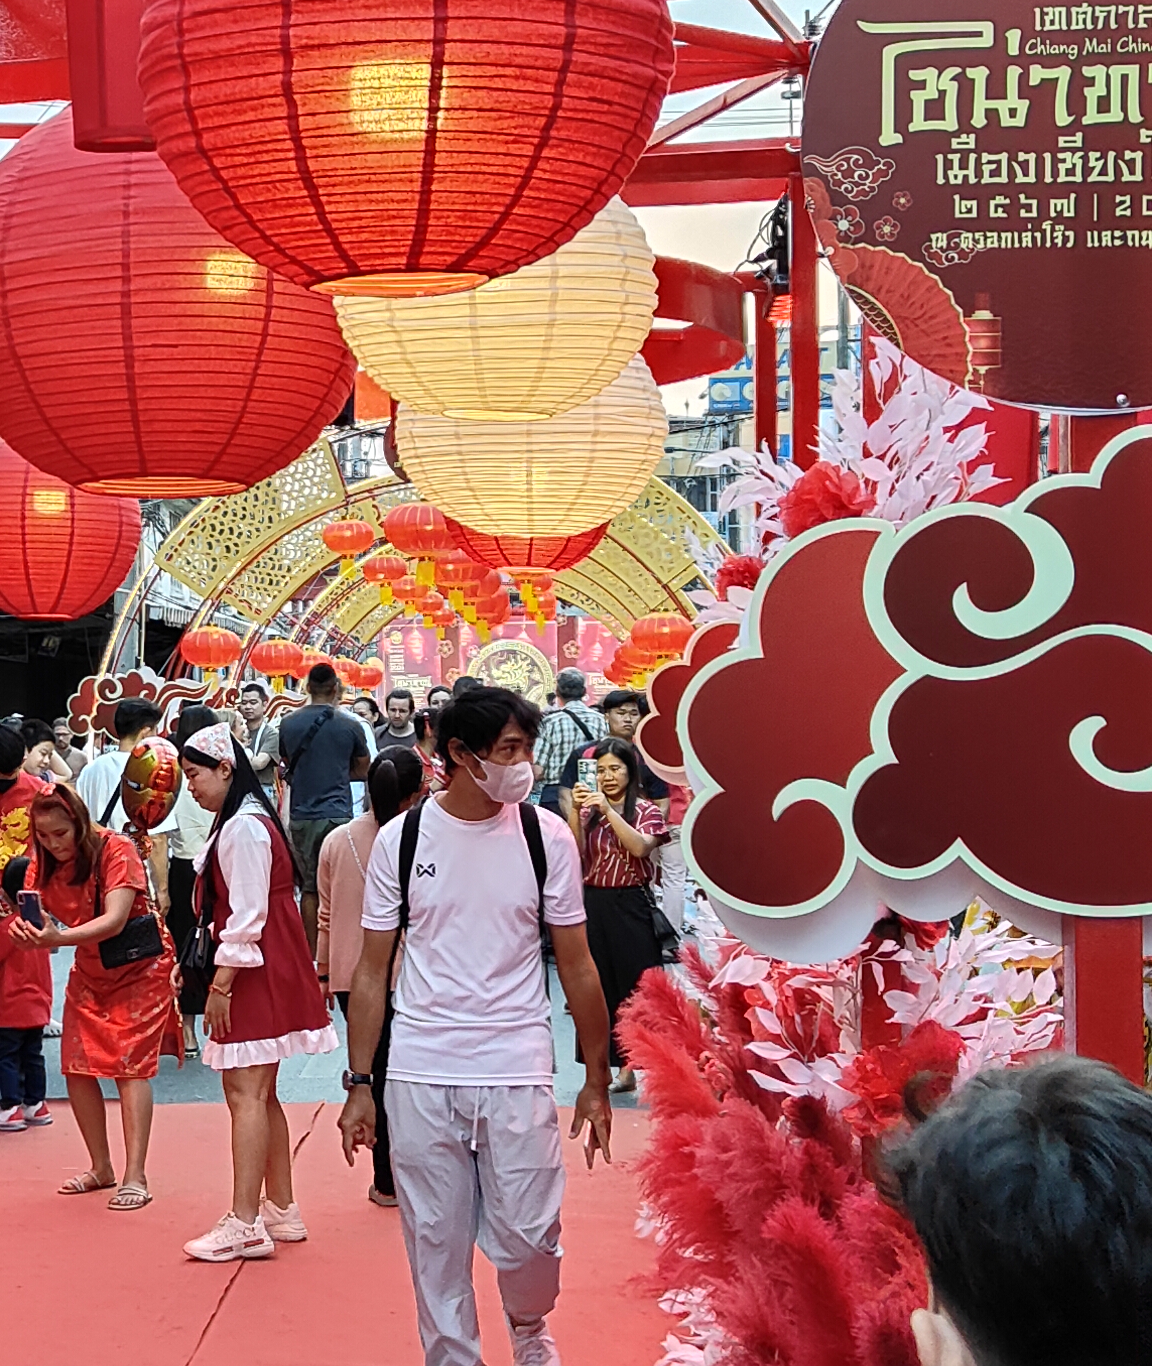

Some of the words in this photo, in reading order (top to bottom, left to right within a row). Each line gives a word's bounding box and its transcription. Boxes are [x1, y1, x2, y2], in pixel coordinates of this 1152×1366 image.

[1025, 37, 1078, 60] Chiang
[1082, 37, 1111, 55] Mai
[1116, 34, 1152, 54] Chin
[856, 19, 1152, 146] ไชน่าท
[953, 192, 1077, 219] ๒๕๖๗
